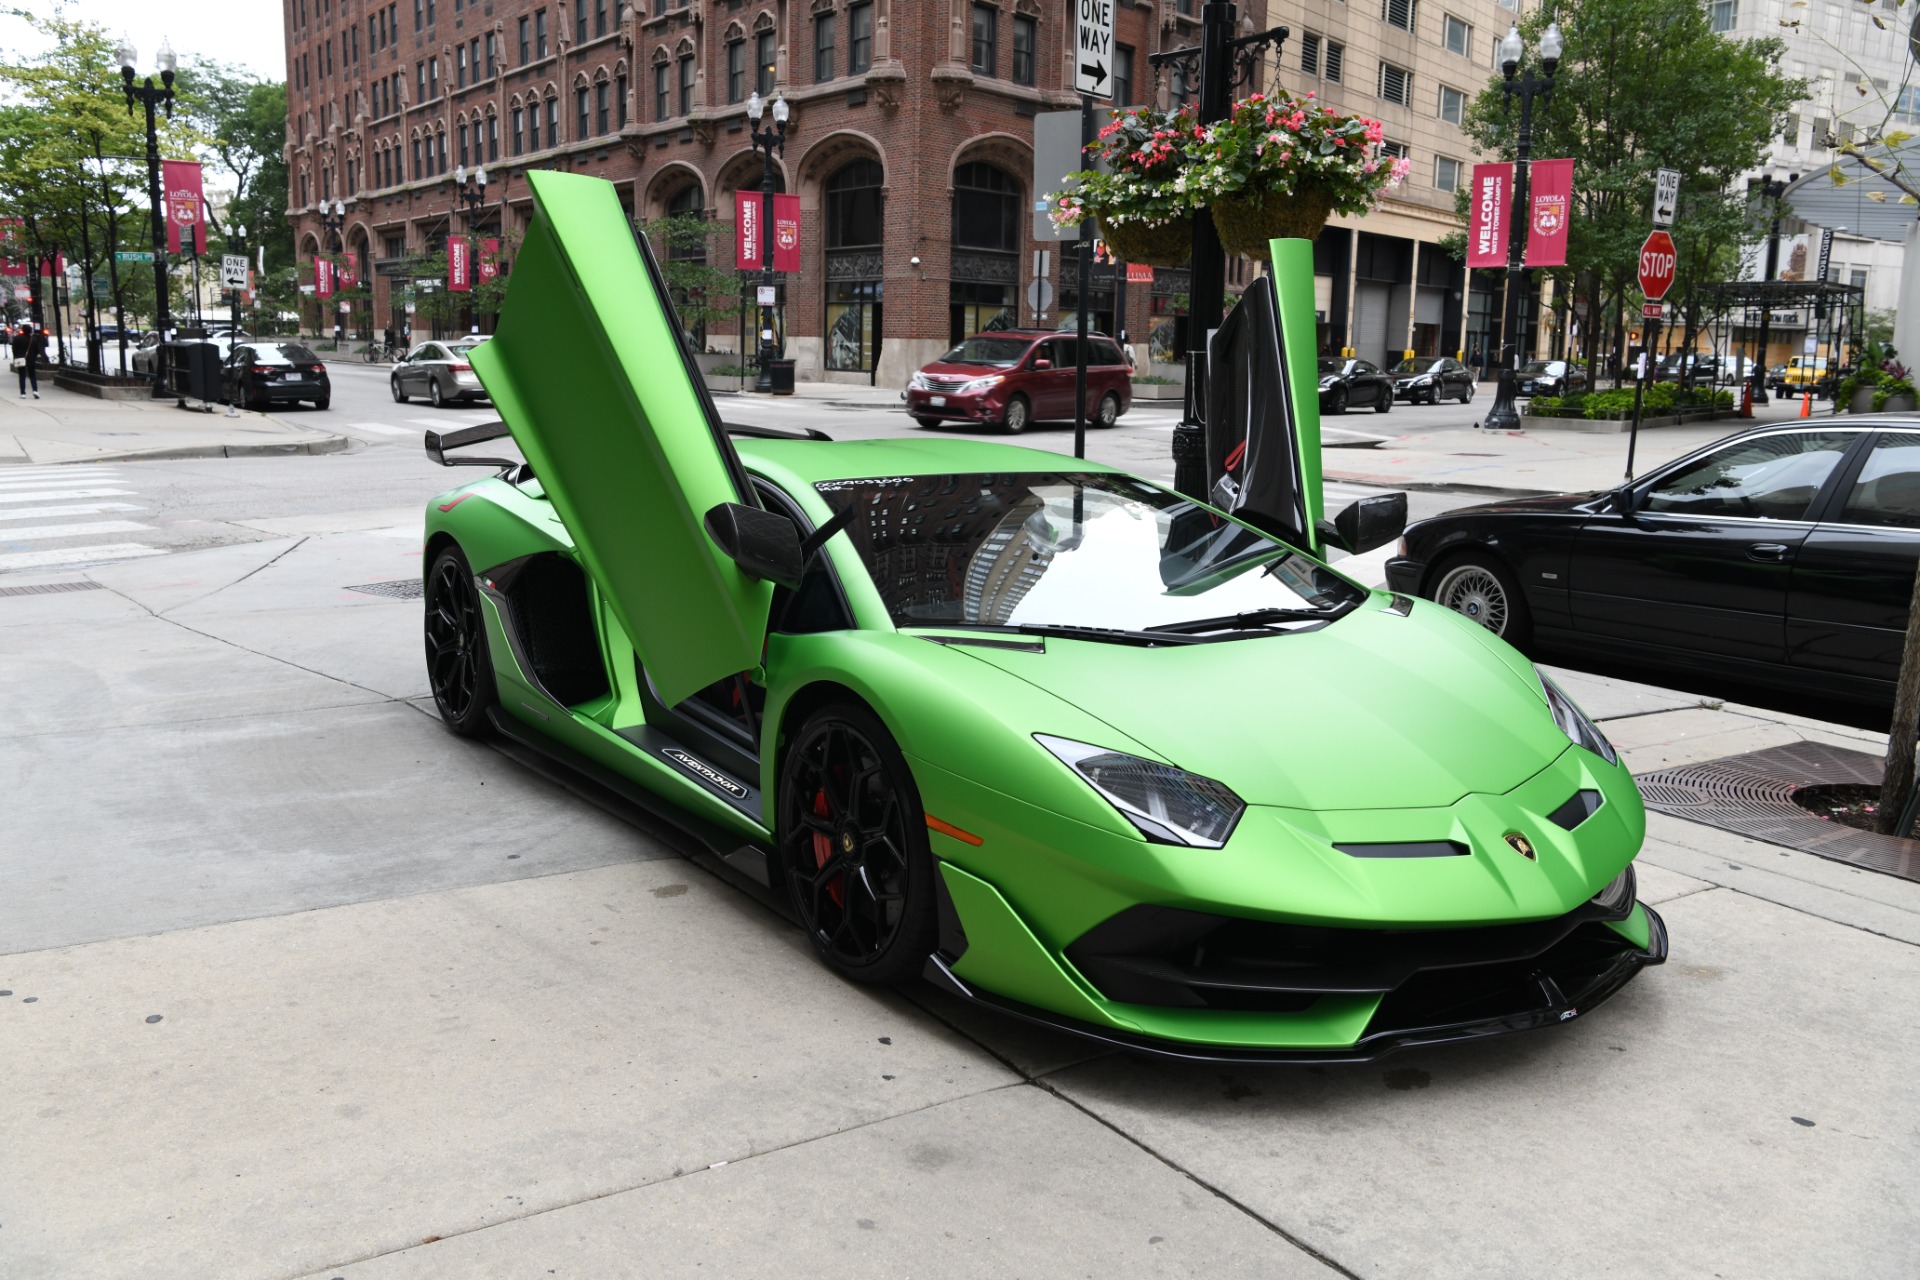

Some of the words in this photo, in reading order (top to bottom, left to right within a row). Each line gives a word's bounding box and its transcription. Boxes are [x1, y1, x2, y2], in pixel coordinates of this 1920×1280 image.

[1082, 0, 1110, 27] ONE
[1080, 25, 1110, 55] WAY
[1660, 174, 1677, 189] ONE
[1535, 194, 1565, 203] LOYOLA
[1658, 189, 1676, 203] WAY
[1478, 176, 1495, 255] WELCOME
[743, 200, 752, 260] WELCOME
[1491, 230, 1499, 255] WATER
[225, 267, 246, 276] WAY
[226, 257, 245, 268] ONE
[1641, 251, 1674, 279] STOP
[674, 753, 740, 792] AVENTADOR
